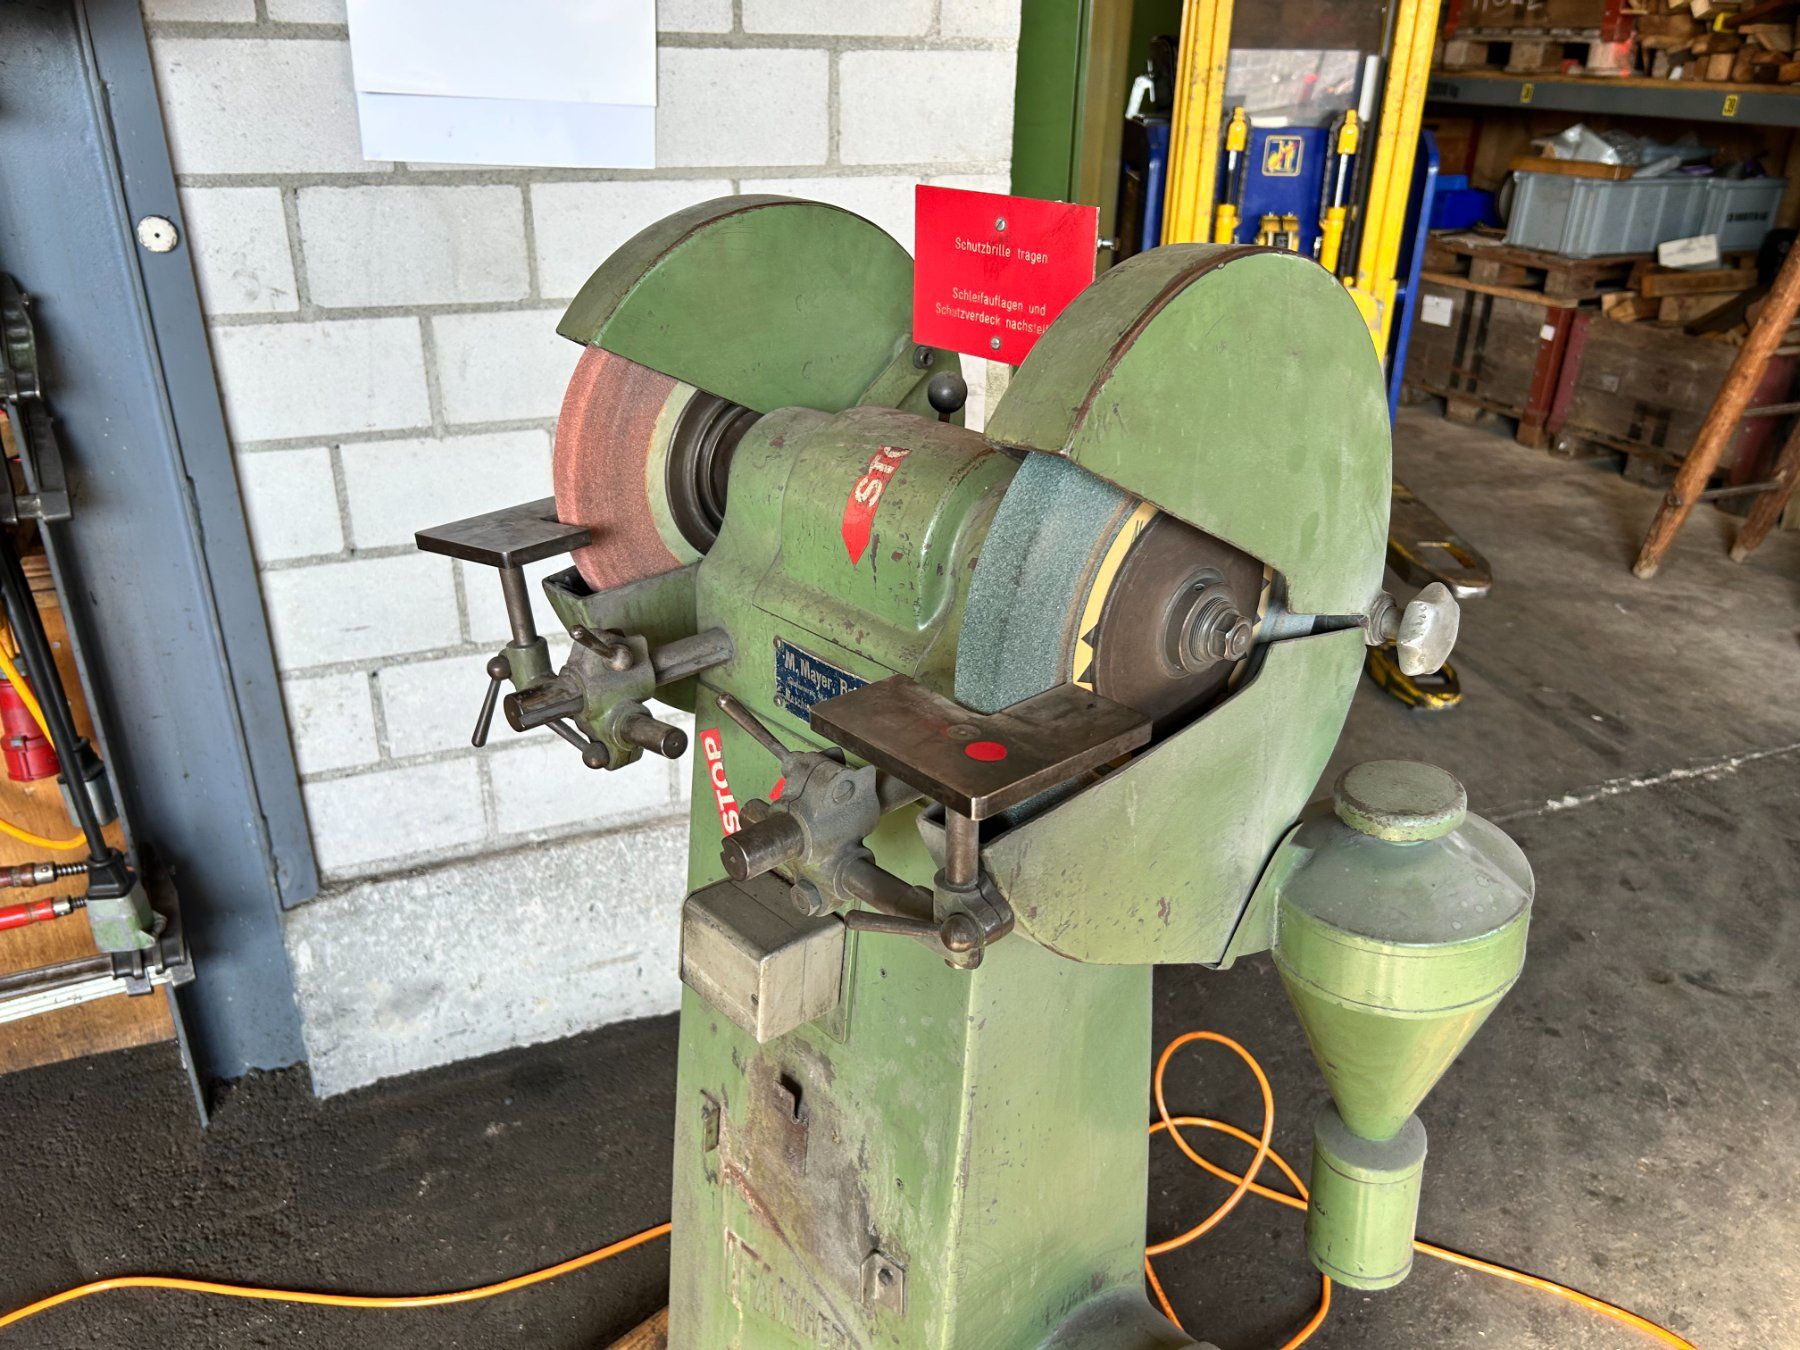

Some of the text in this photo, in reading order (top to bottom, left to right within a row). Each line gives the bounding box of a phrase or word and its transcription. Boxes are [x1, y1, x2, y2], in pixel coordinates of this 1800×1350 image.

[955, 237, 1048, 265] Schutzbrille tragen
[935, 302, 1001, 326] Schutzverdeck
[952, 287, 1046, 317] Schleifauflagen und
[704, 736, 742, 834] STOP
